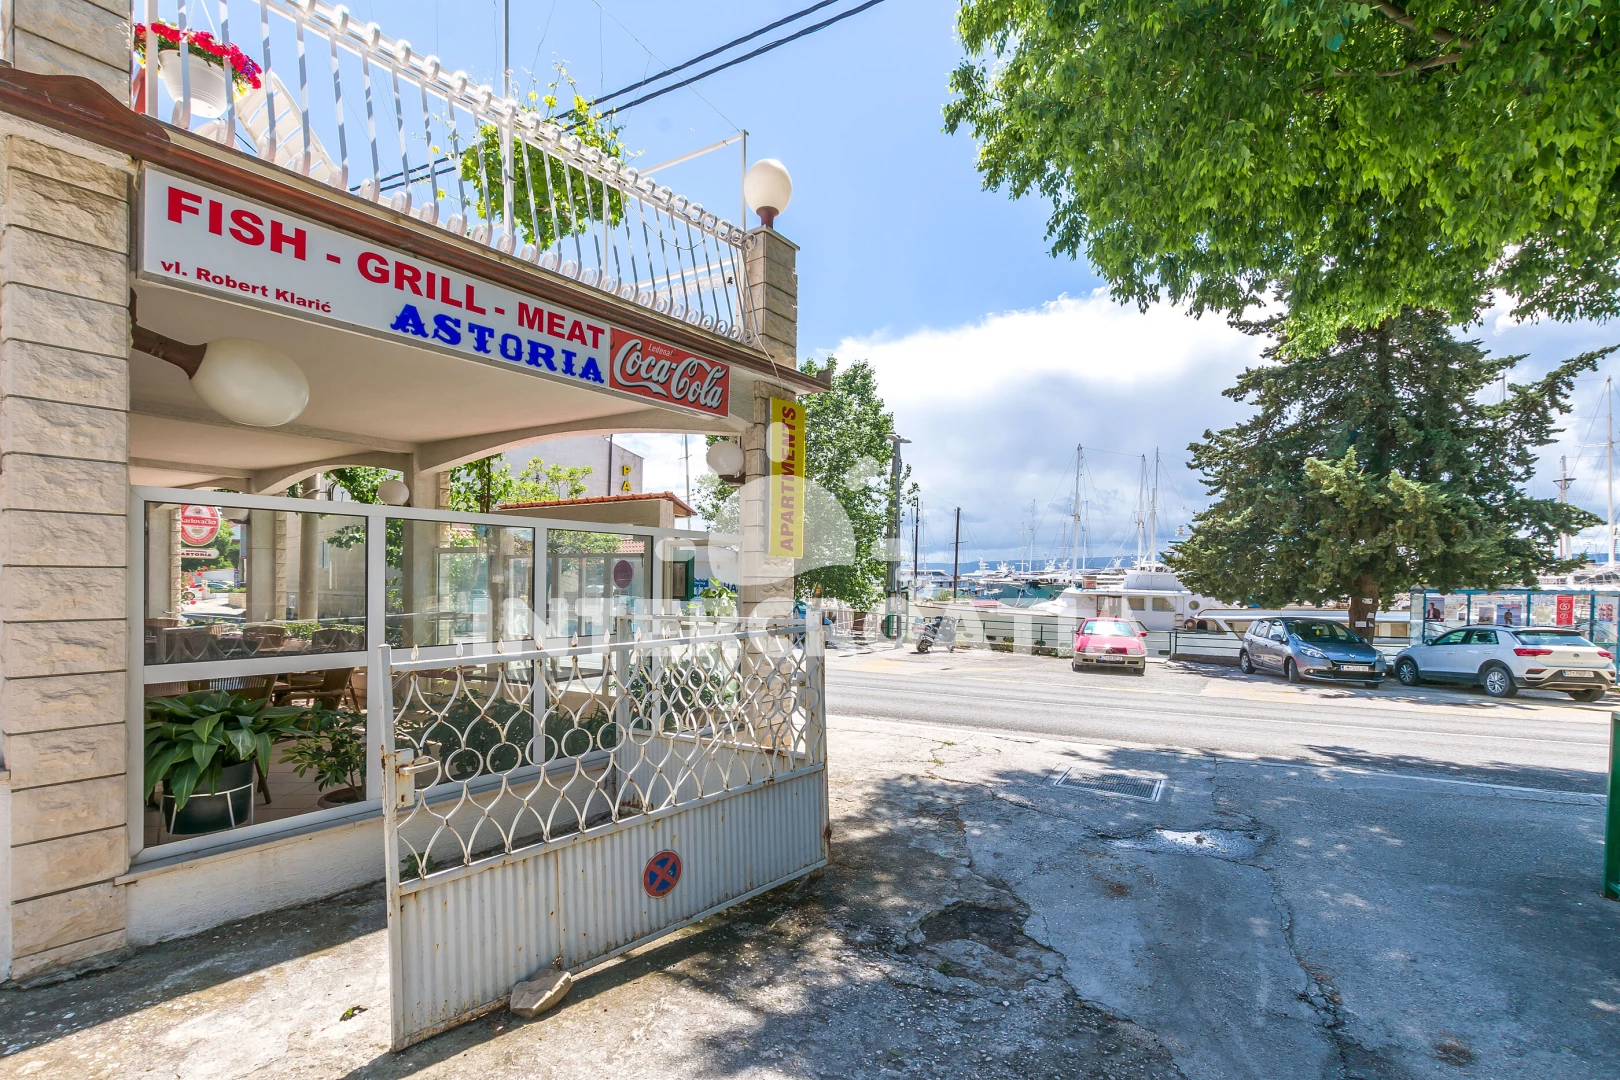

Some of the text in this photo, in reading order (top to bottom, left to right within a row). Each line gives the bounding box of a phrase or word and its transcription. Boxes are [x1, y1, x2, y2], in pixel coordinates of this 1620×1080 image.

[160, 260, 332, 313] vl. Robert Klarić
[167, 185, 307, 261] FISH
[357, 251, 486, 315] GRILL
[518, 301, 605, 350] MEAT
[390, 303, 605, 384] ASTORIA
[780, 405, 797, 552] APARTMENTS
